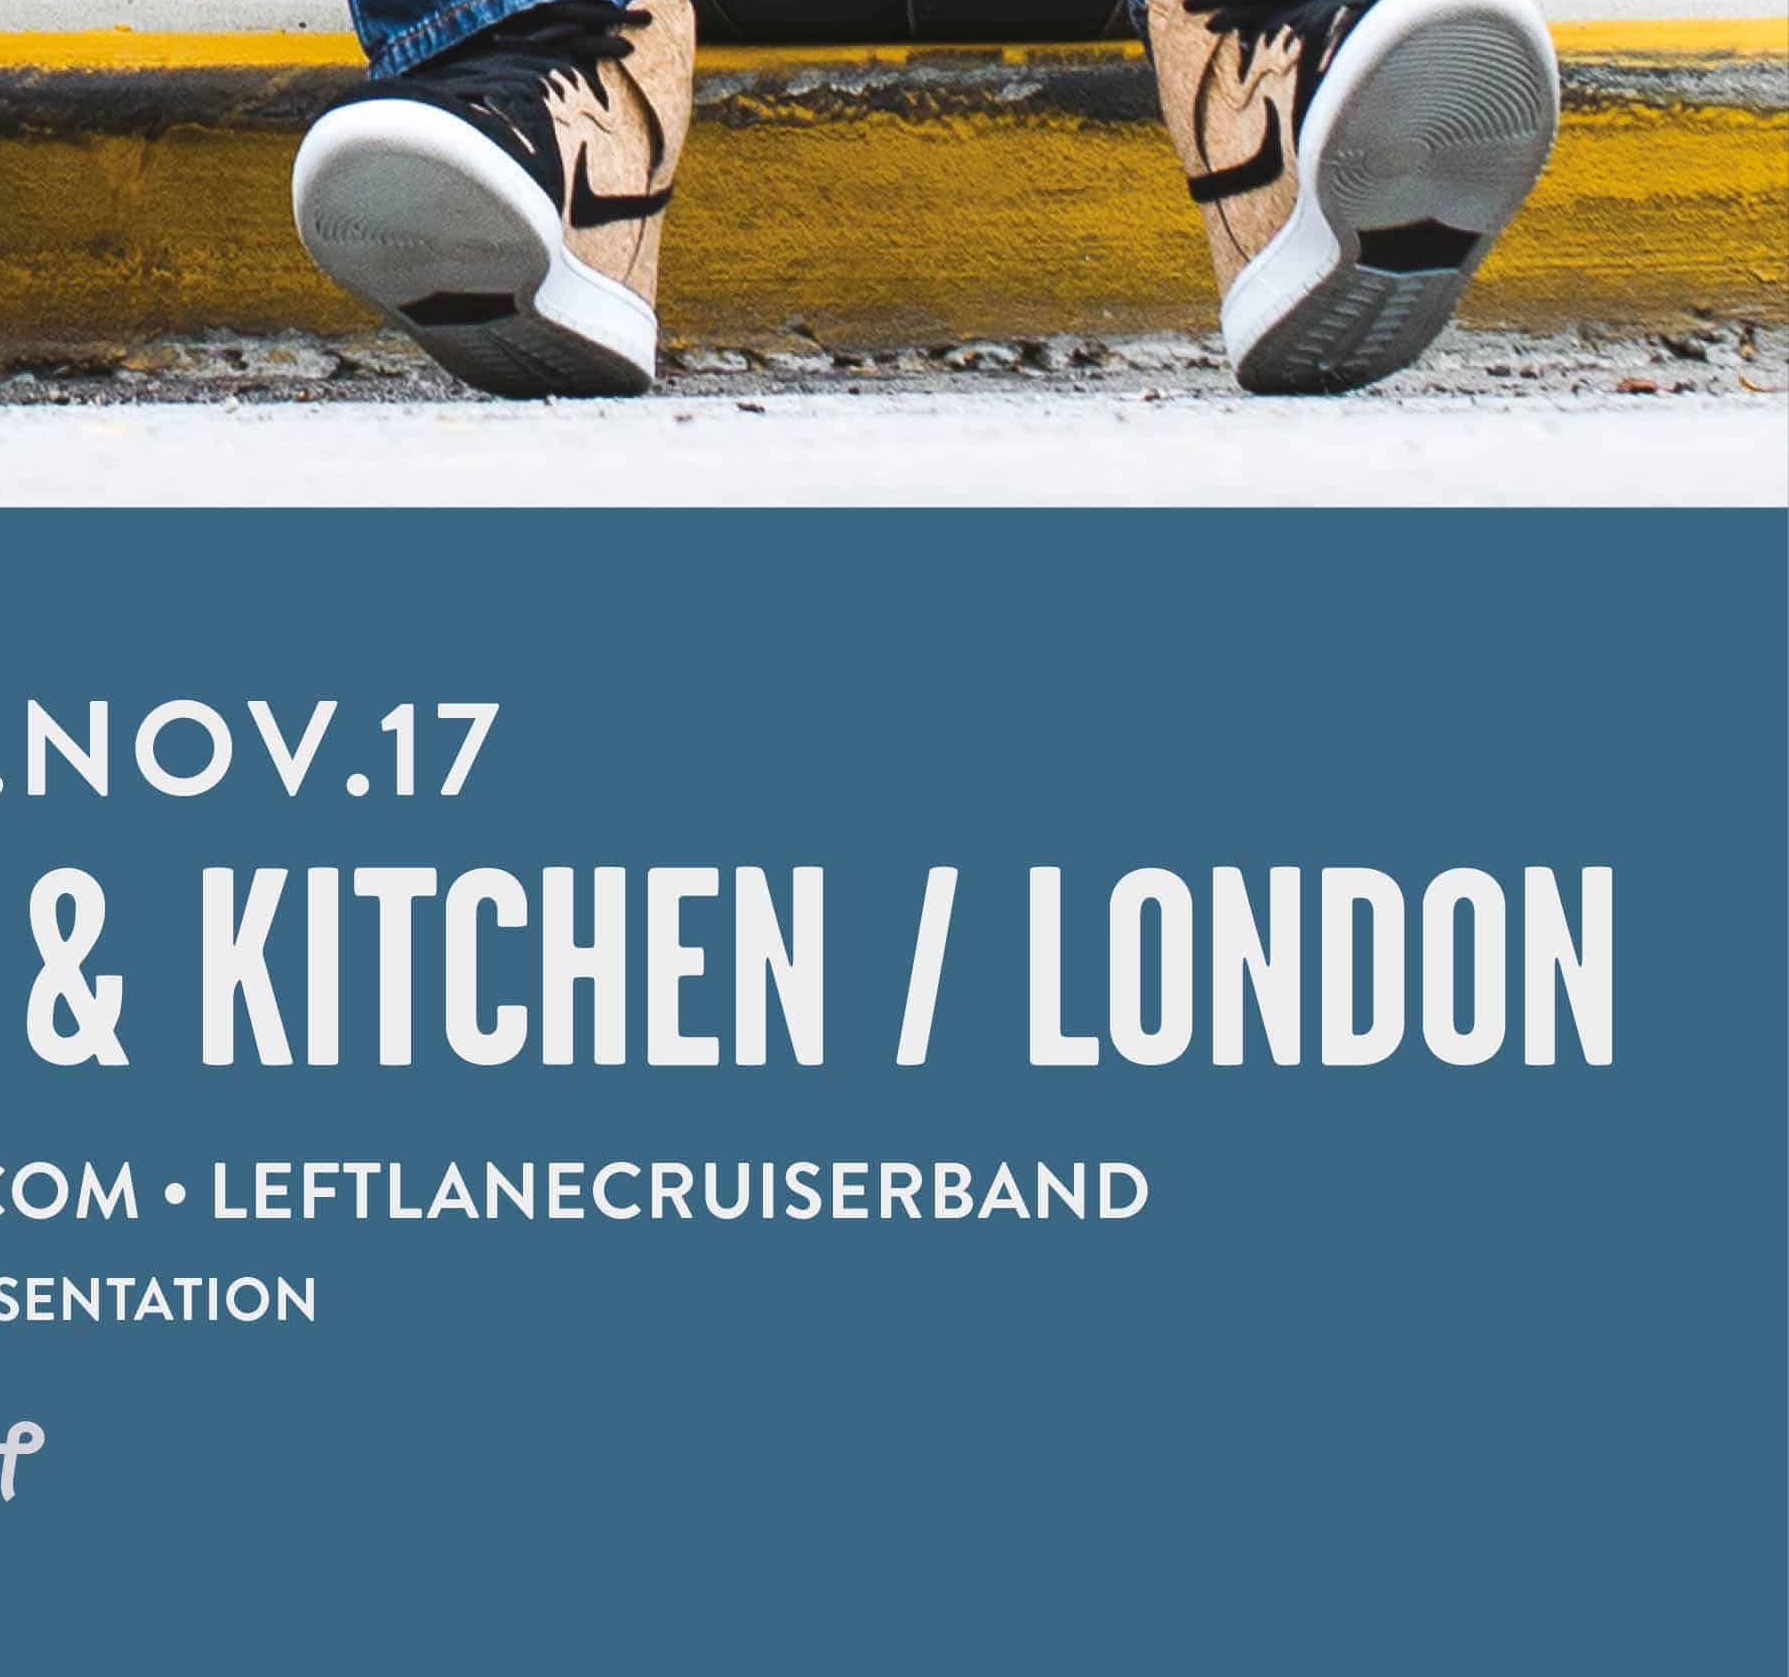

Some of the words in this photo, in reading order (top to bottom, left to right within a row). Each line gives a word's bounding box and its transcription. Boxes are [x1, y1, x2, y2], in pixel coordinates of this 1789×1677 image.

[26, 867, 130, 1066] &
[202, 866, 824, 1066] KITCHEN
[896, 866, 959, 1066] /
[1029, 866, 1613, 1066] LONDON
[214, 1161, 1149, 1220] LEFTLANECRUISERBAND
